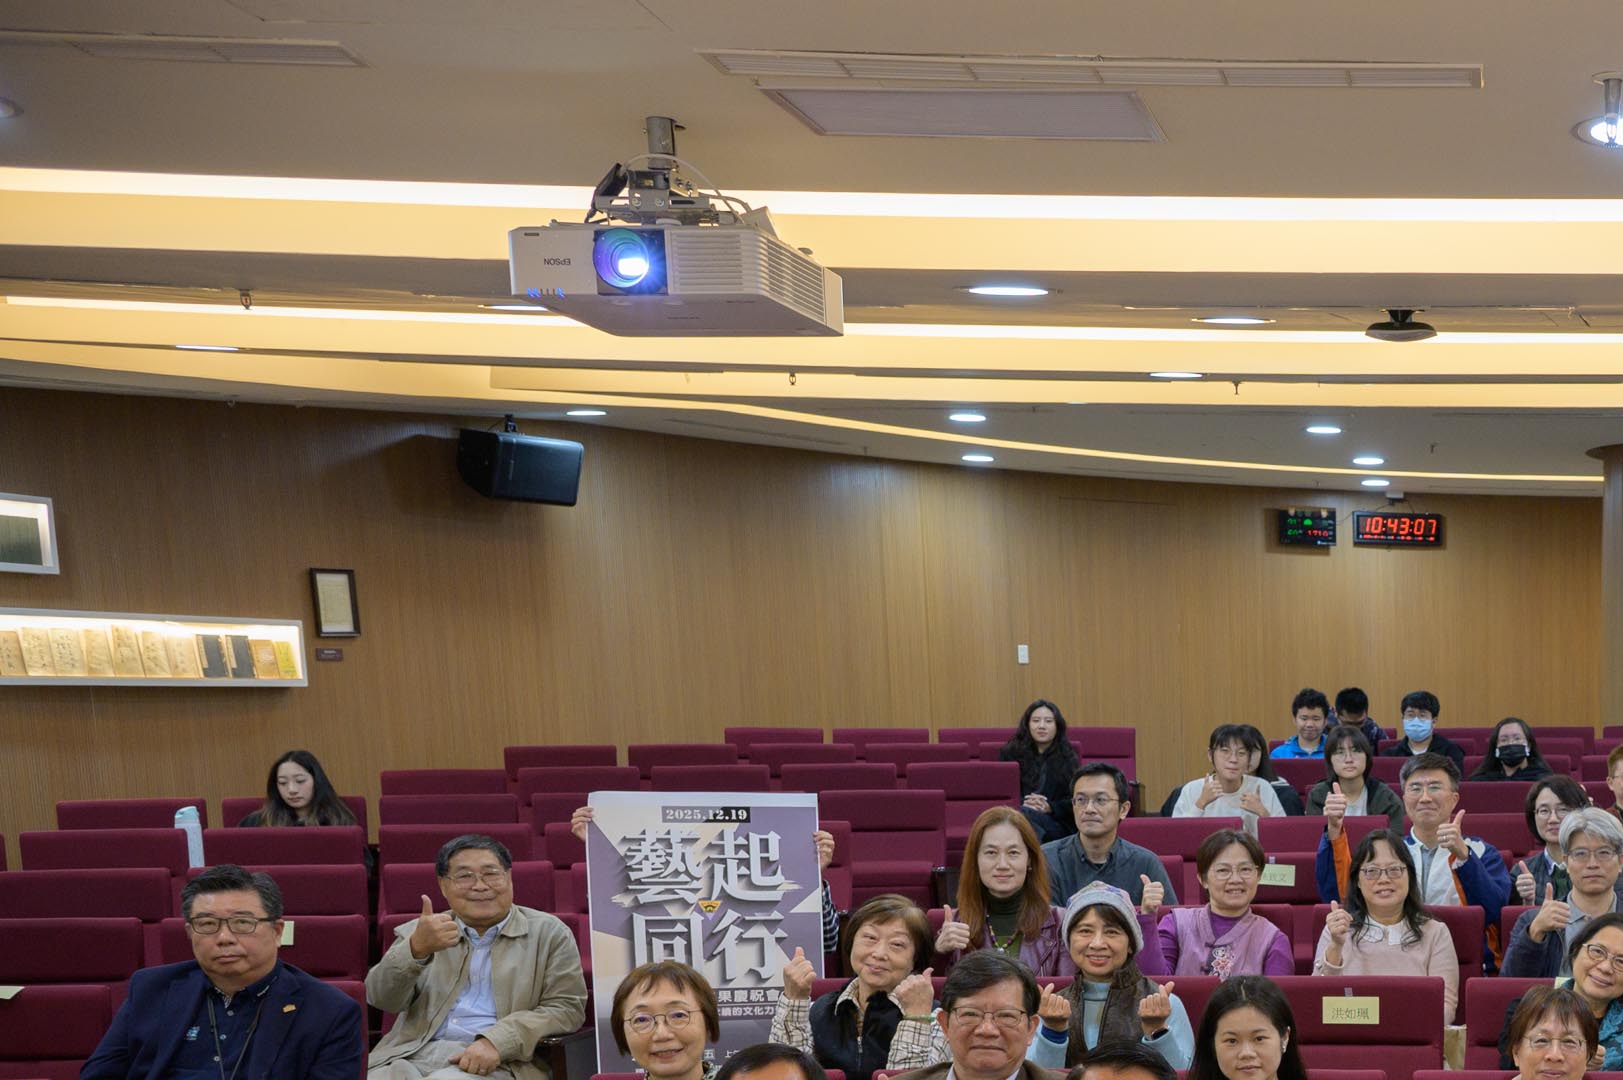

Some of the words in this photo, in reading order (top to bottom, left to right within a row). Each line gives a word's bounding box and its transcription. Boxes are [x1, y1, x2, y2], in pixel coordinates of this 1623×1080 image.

[543, 257, 572, 266] EPSON
[1365, 516, 1437, 535] 10:43:07
[665, 808, 748, 821] 2025.12.19
[624, 828, 786, 904] 藝起
[632, 908, 789, 981] 同行
[713, 988, 780, 1003] 果慶祝會
